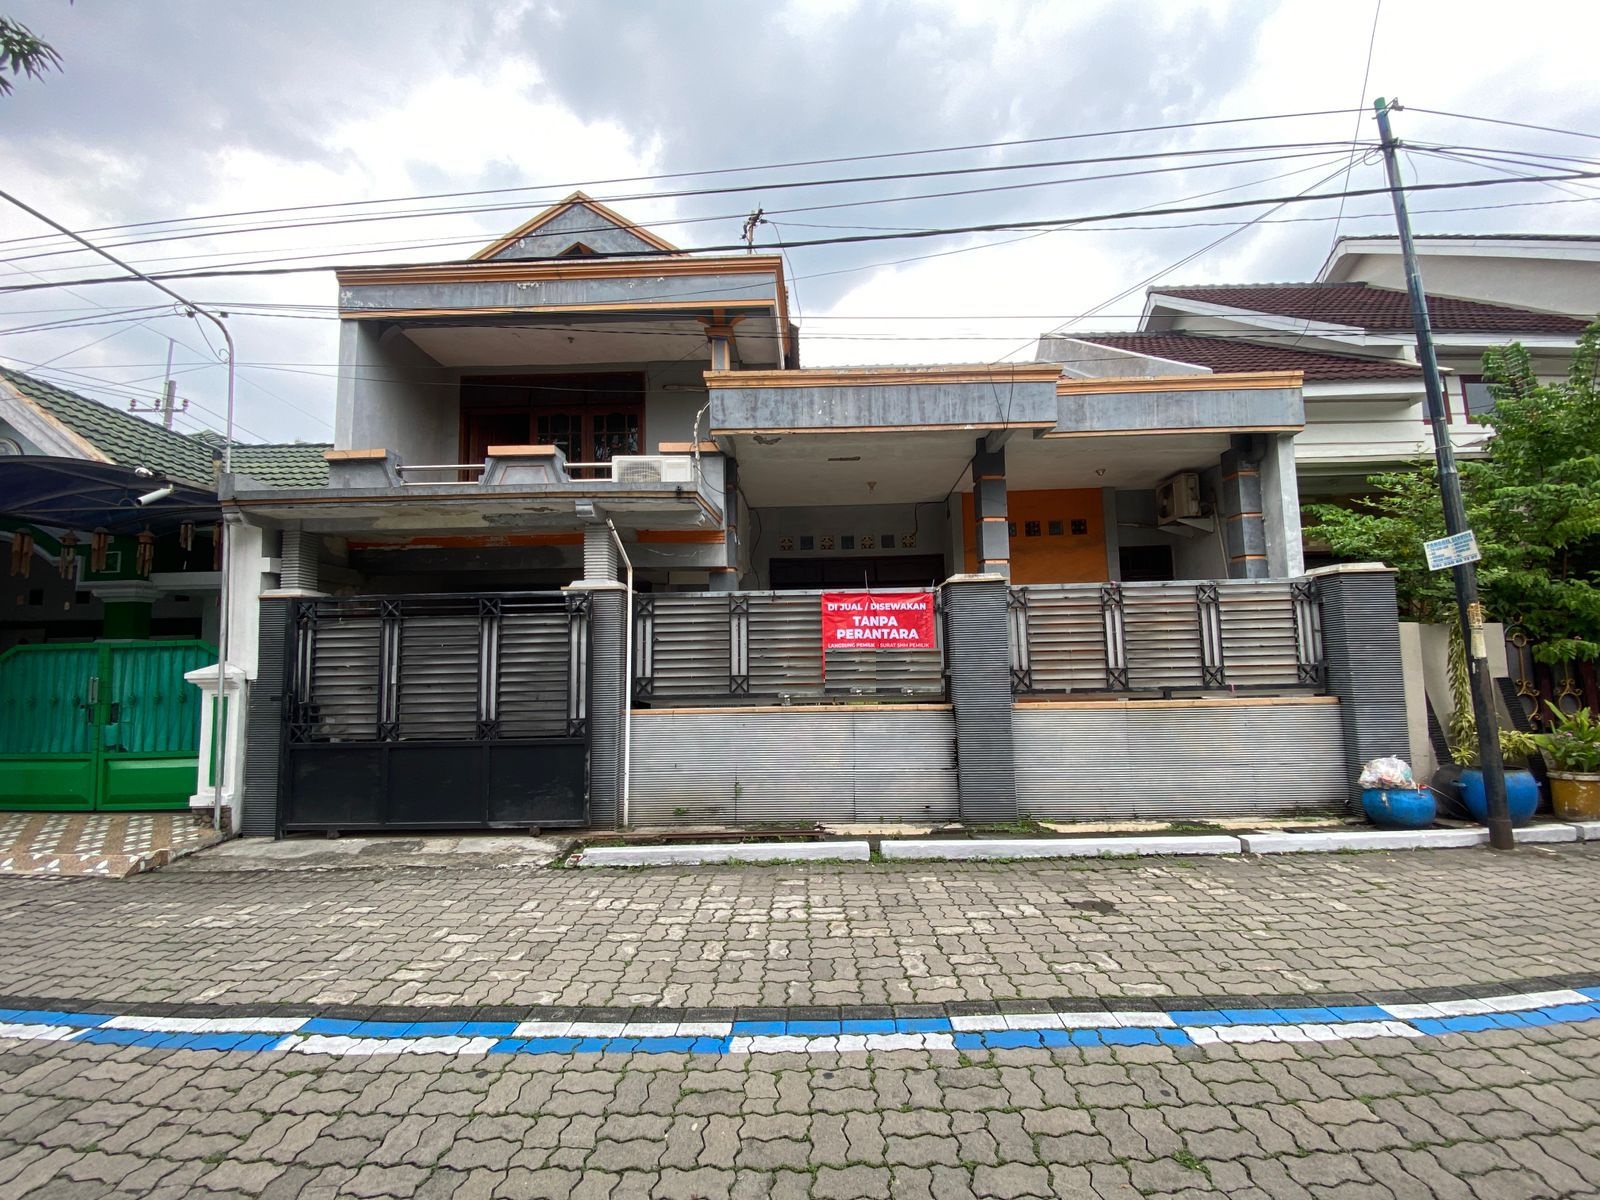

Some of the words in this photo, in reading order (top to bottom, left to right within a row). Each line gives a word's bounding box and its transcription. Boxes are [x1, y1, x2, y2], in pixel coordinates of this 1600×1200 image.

[828, 603, 837, 611] DI
[840, 603, 862, 611] JUAL
[870, 602, 926, 611] DISEWAKAN
[852, 615, 898, 627] TANPA
[836, 628, 919, 640] PERANTARA
